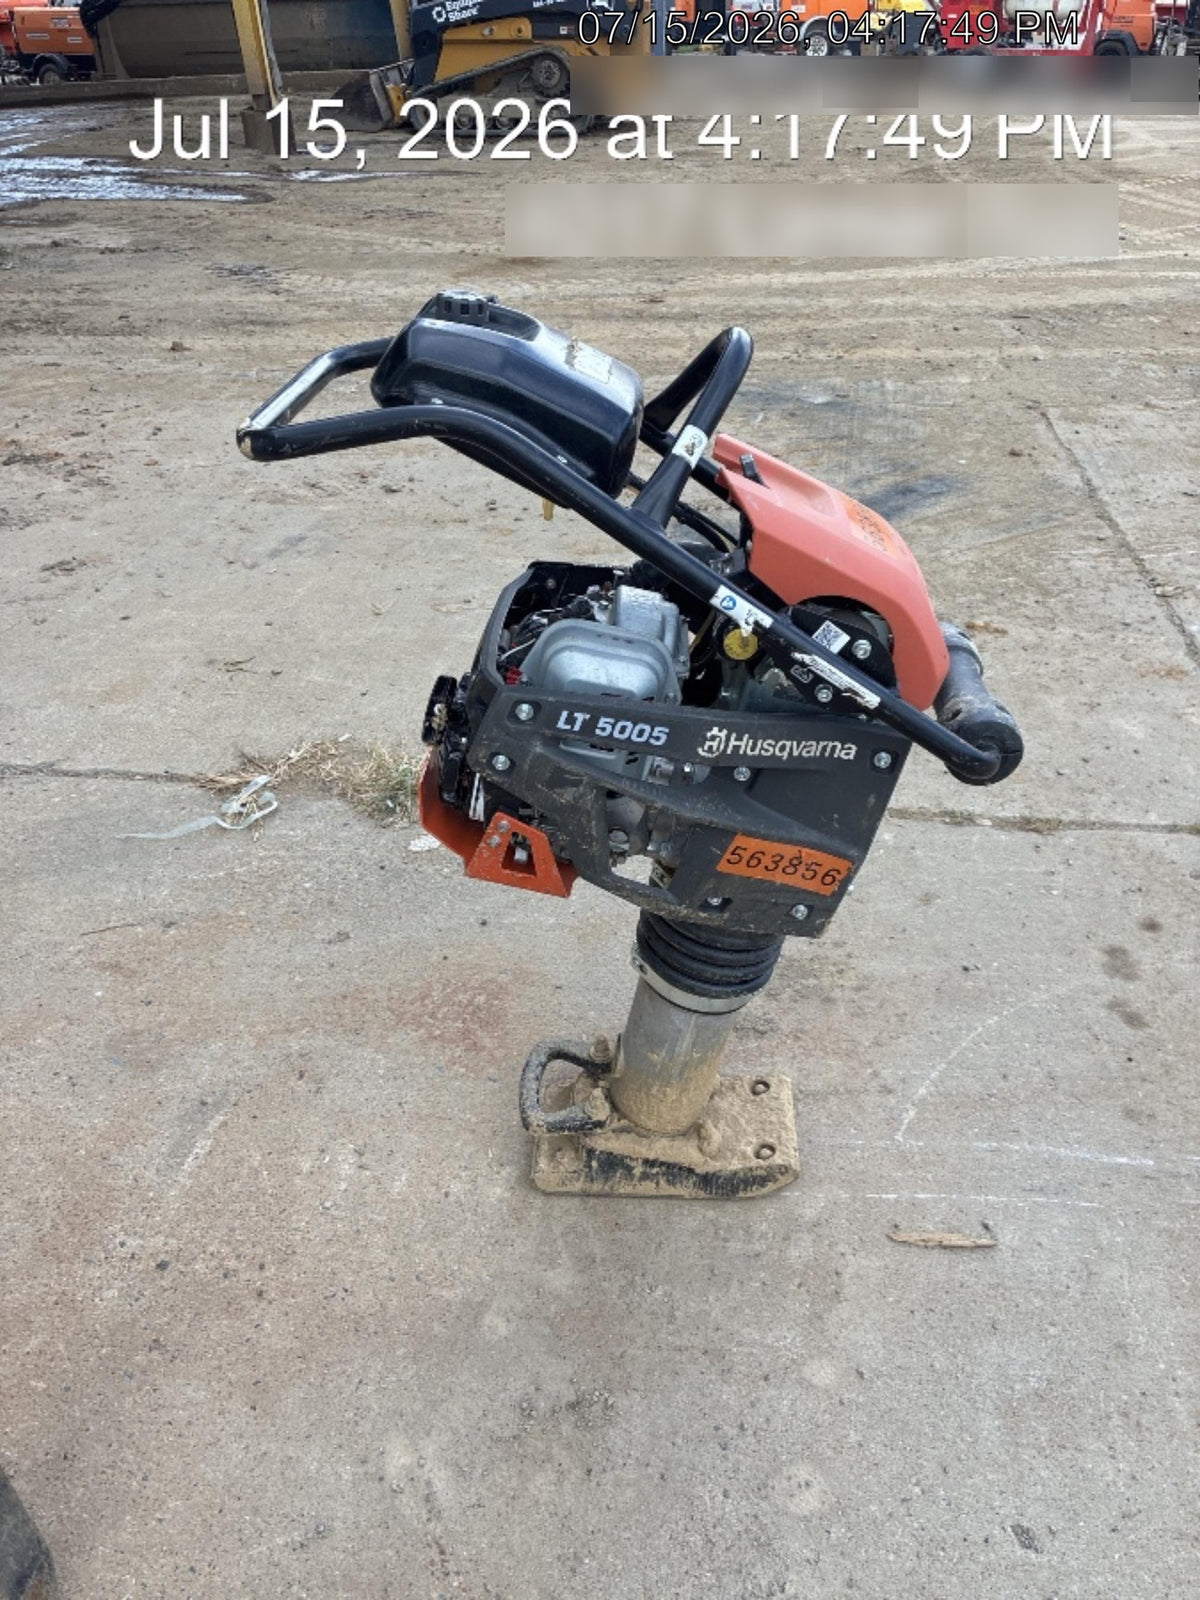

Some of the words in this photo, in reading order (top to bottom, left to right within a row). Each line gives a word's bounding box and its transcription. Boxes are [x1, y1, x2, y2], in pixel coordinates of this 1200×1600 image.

[556, 710, 591, 732] LT
[595, 717, 669, 746] 5005
[727, 732, 858, 761] Husqvarna
[726, 845, 842, 887] 563856
